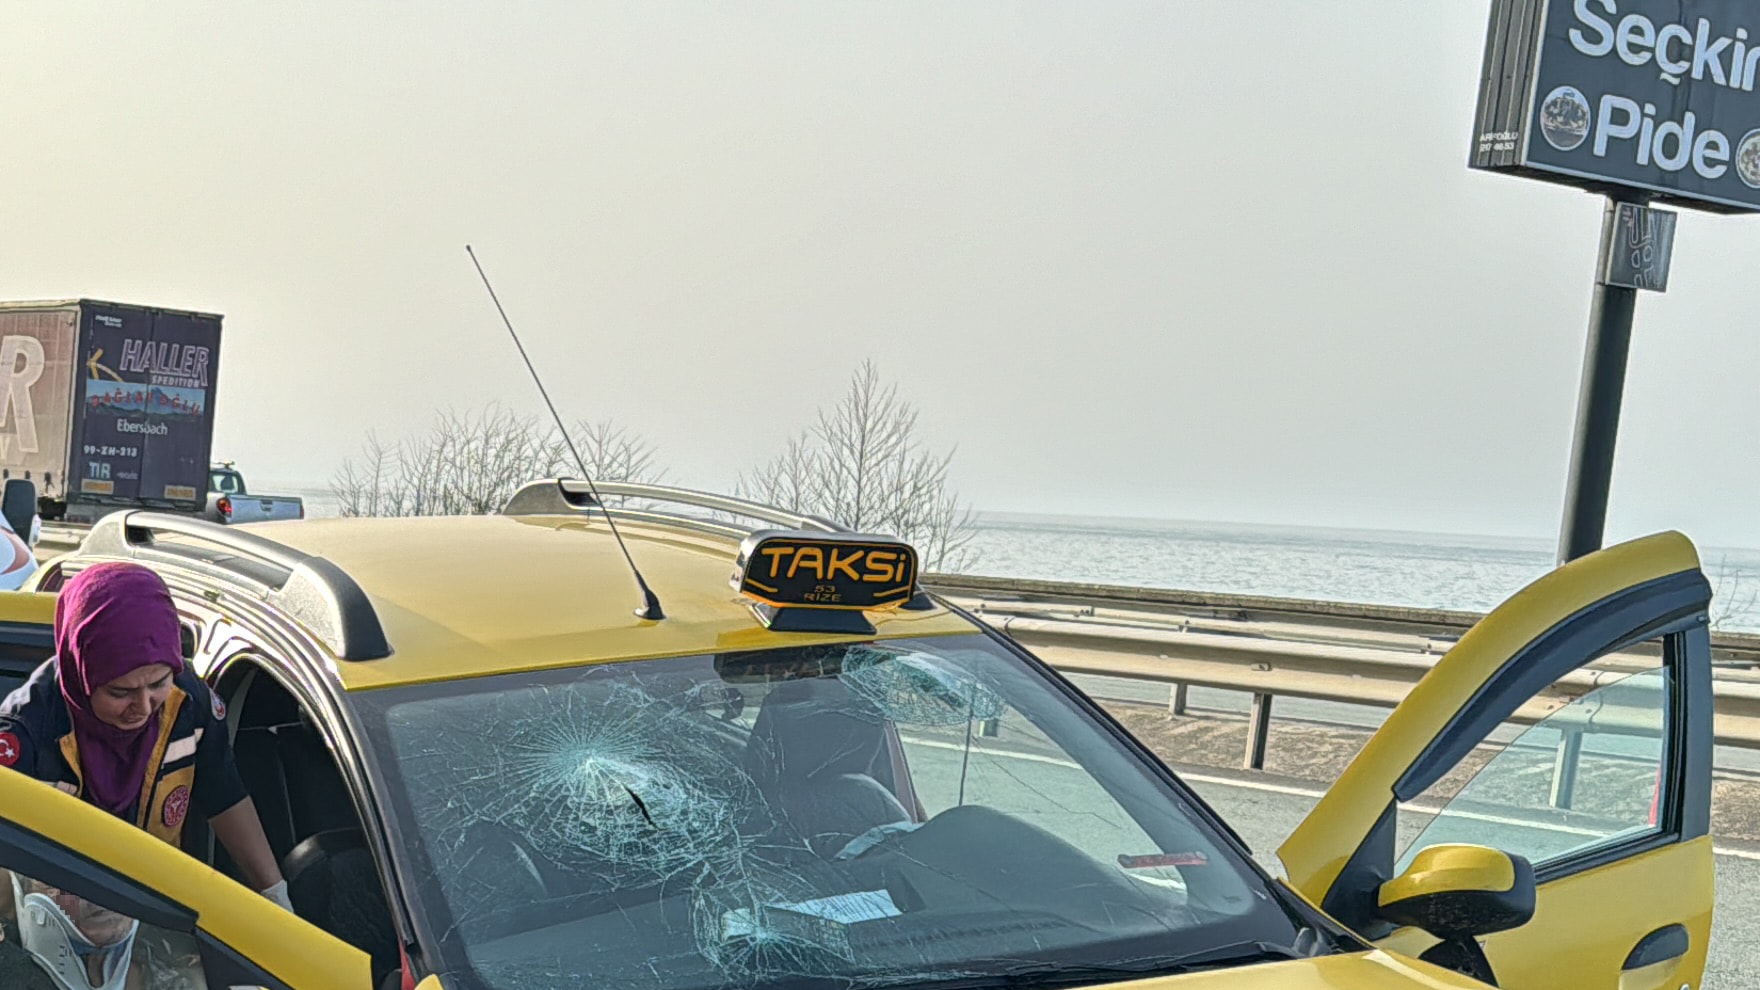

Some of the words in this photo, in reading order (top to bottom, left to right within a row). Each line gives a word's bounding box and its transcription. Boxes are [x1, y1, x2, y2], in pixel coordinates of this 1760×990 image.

[1592, 93, 1730, 179] Pide
[119, 339, 210, 387] HALLER
[151, 375, 201, 388] SPEDITION
[116, 418, 169, 435] Ebersbach
